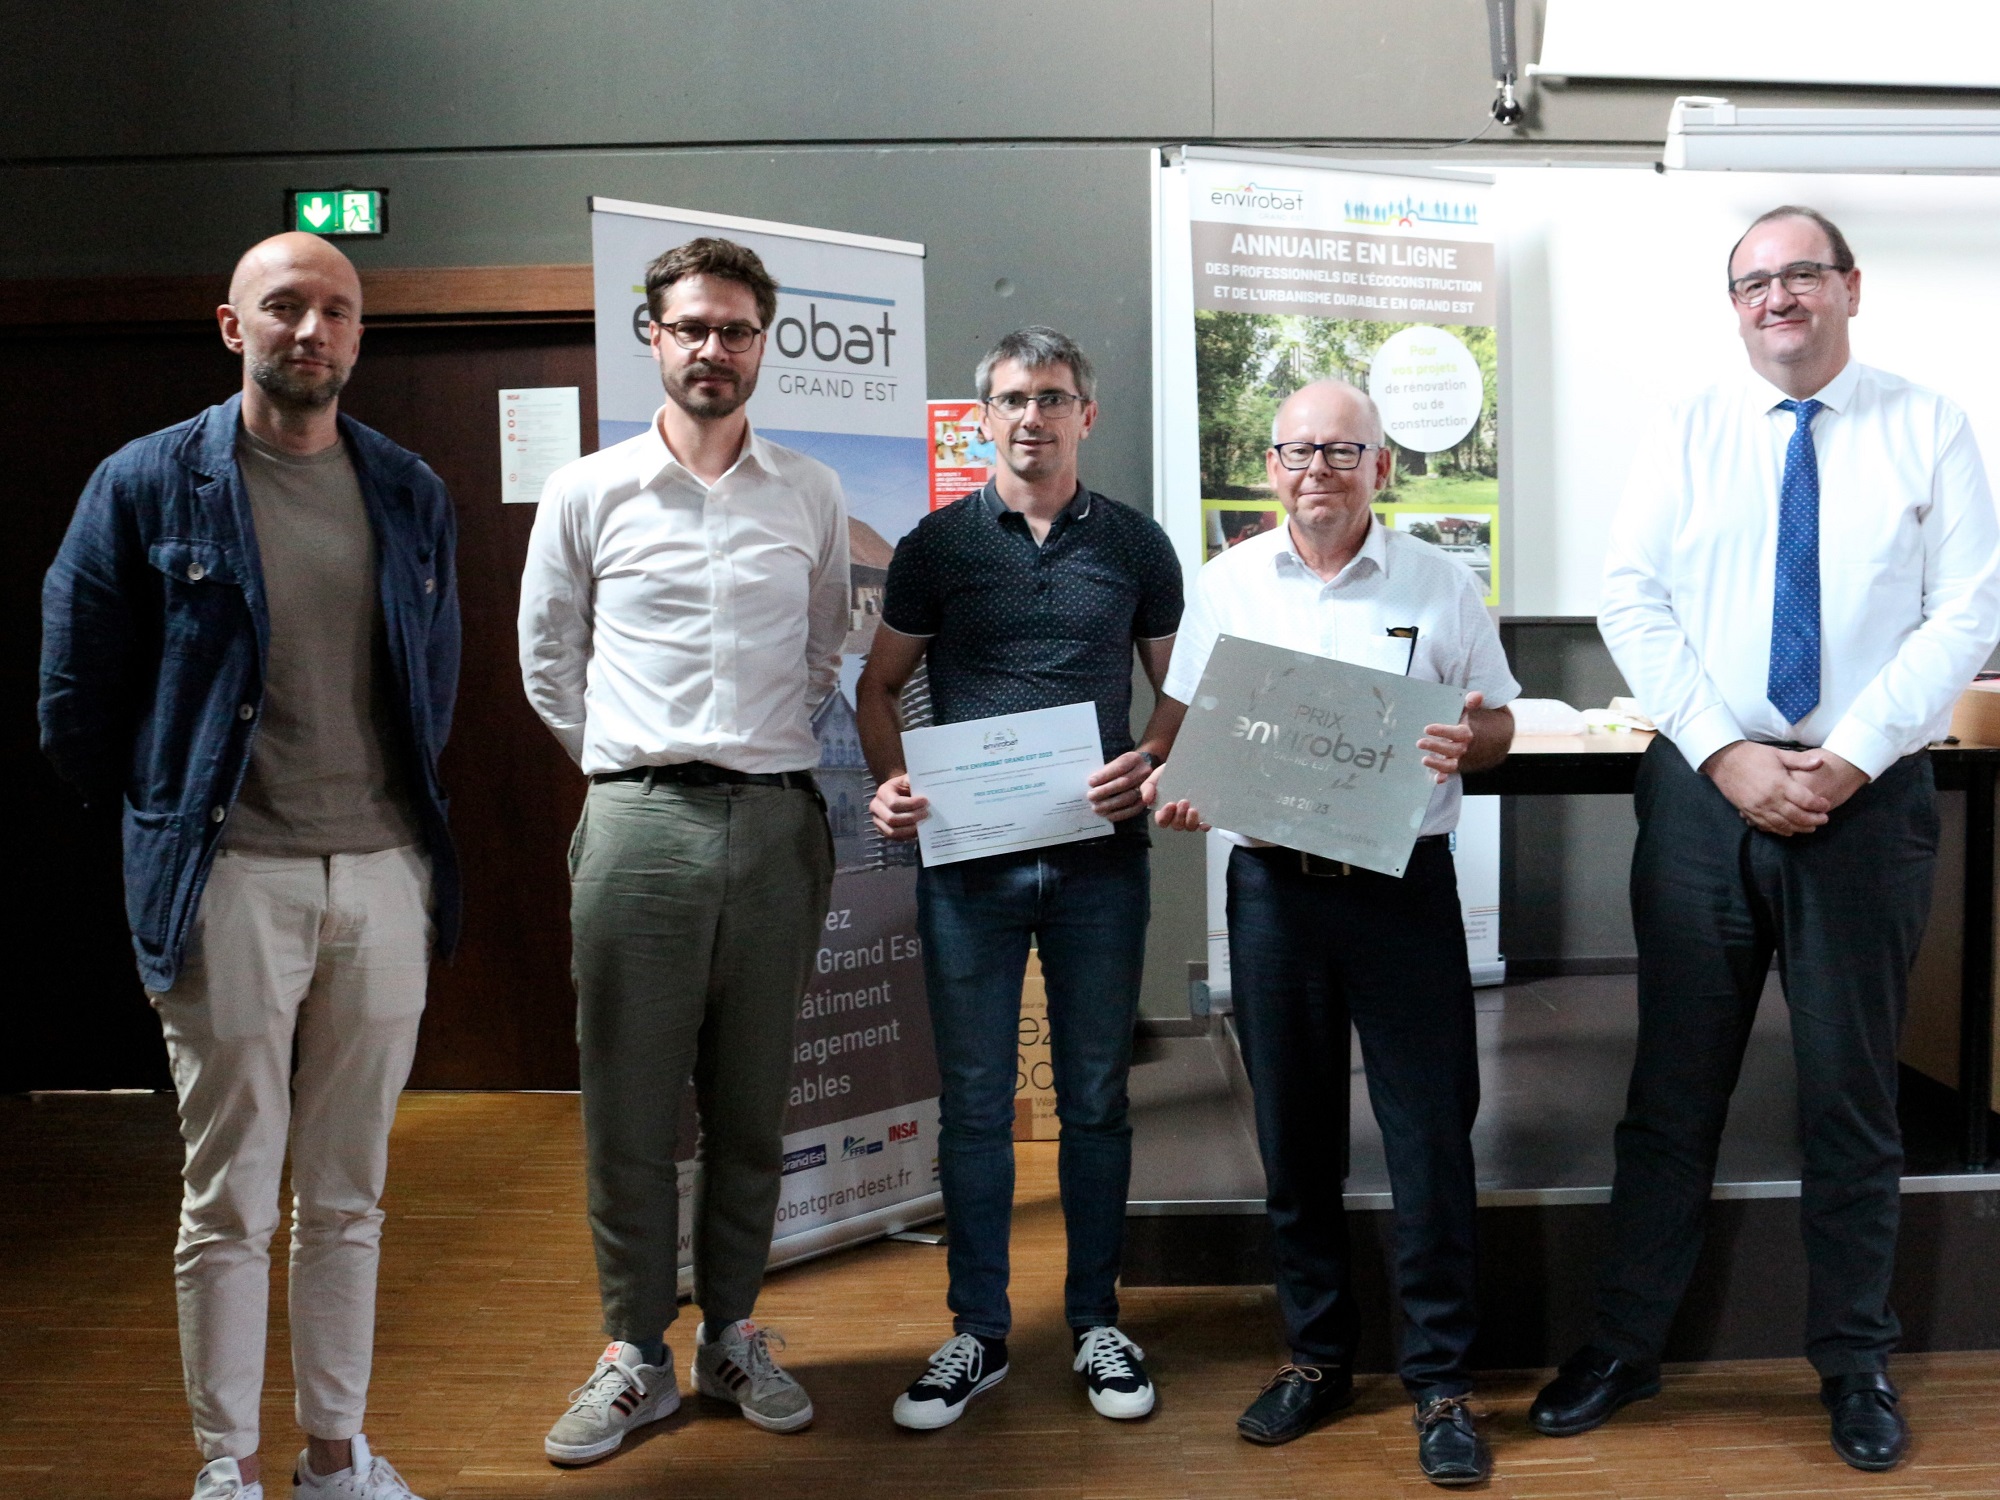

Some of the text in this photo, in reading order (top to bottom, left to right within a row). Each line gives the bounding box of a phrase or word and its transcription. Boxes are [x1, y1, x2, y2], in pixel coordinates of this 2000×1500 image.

[1211, 191, 1303, 211] envirobat
[1231, 232, 1458, 270] ANNUAIRE EN LIGNE
[1205, 262, 1483, 293] DES PROFESSIONNELS DE L'ÉCOCONSTRUCTION
[1213, 285, 1475, 314] ET DE L'URBANISME DURABLE EN GRAND EST
[633, 302, 897, 368] eobat
[1409, 345, 1437, 356] Pour
[1391, 363, 1458, 376] vos projets
[779, 374, 898, 402] GRAND EST
[1385, 383, 1400, 394] de
[1412, 399, 1445, 411] ou de
[1391, 415, 1468, 430] construction
[1294, 704, 1346, 730] PRIX
[816, 938, 884, 974] Grand
[799, 980, 892, 1020] âtiment
[790, 1074, 852, 1108] ables
[888, 1120, 918, 1142] INSA
[776, 1168, 912, 1222] obatgrandest.fr
